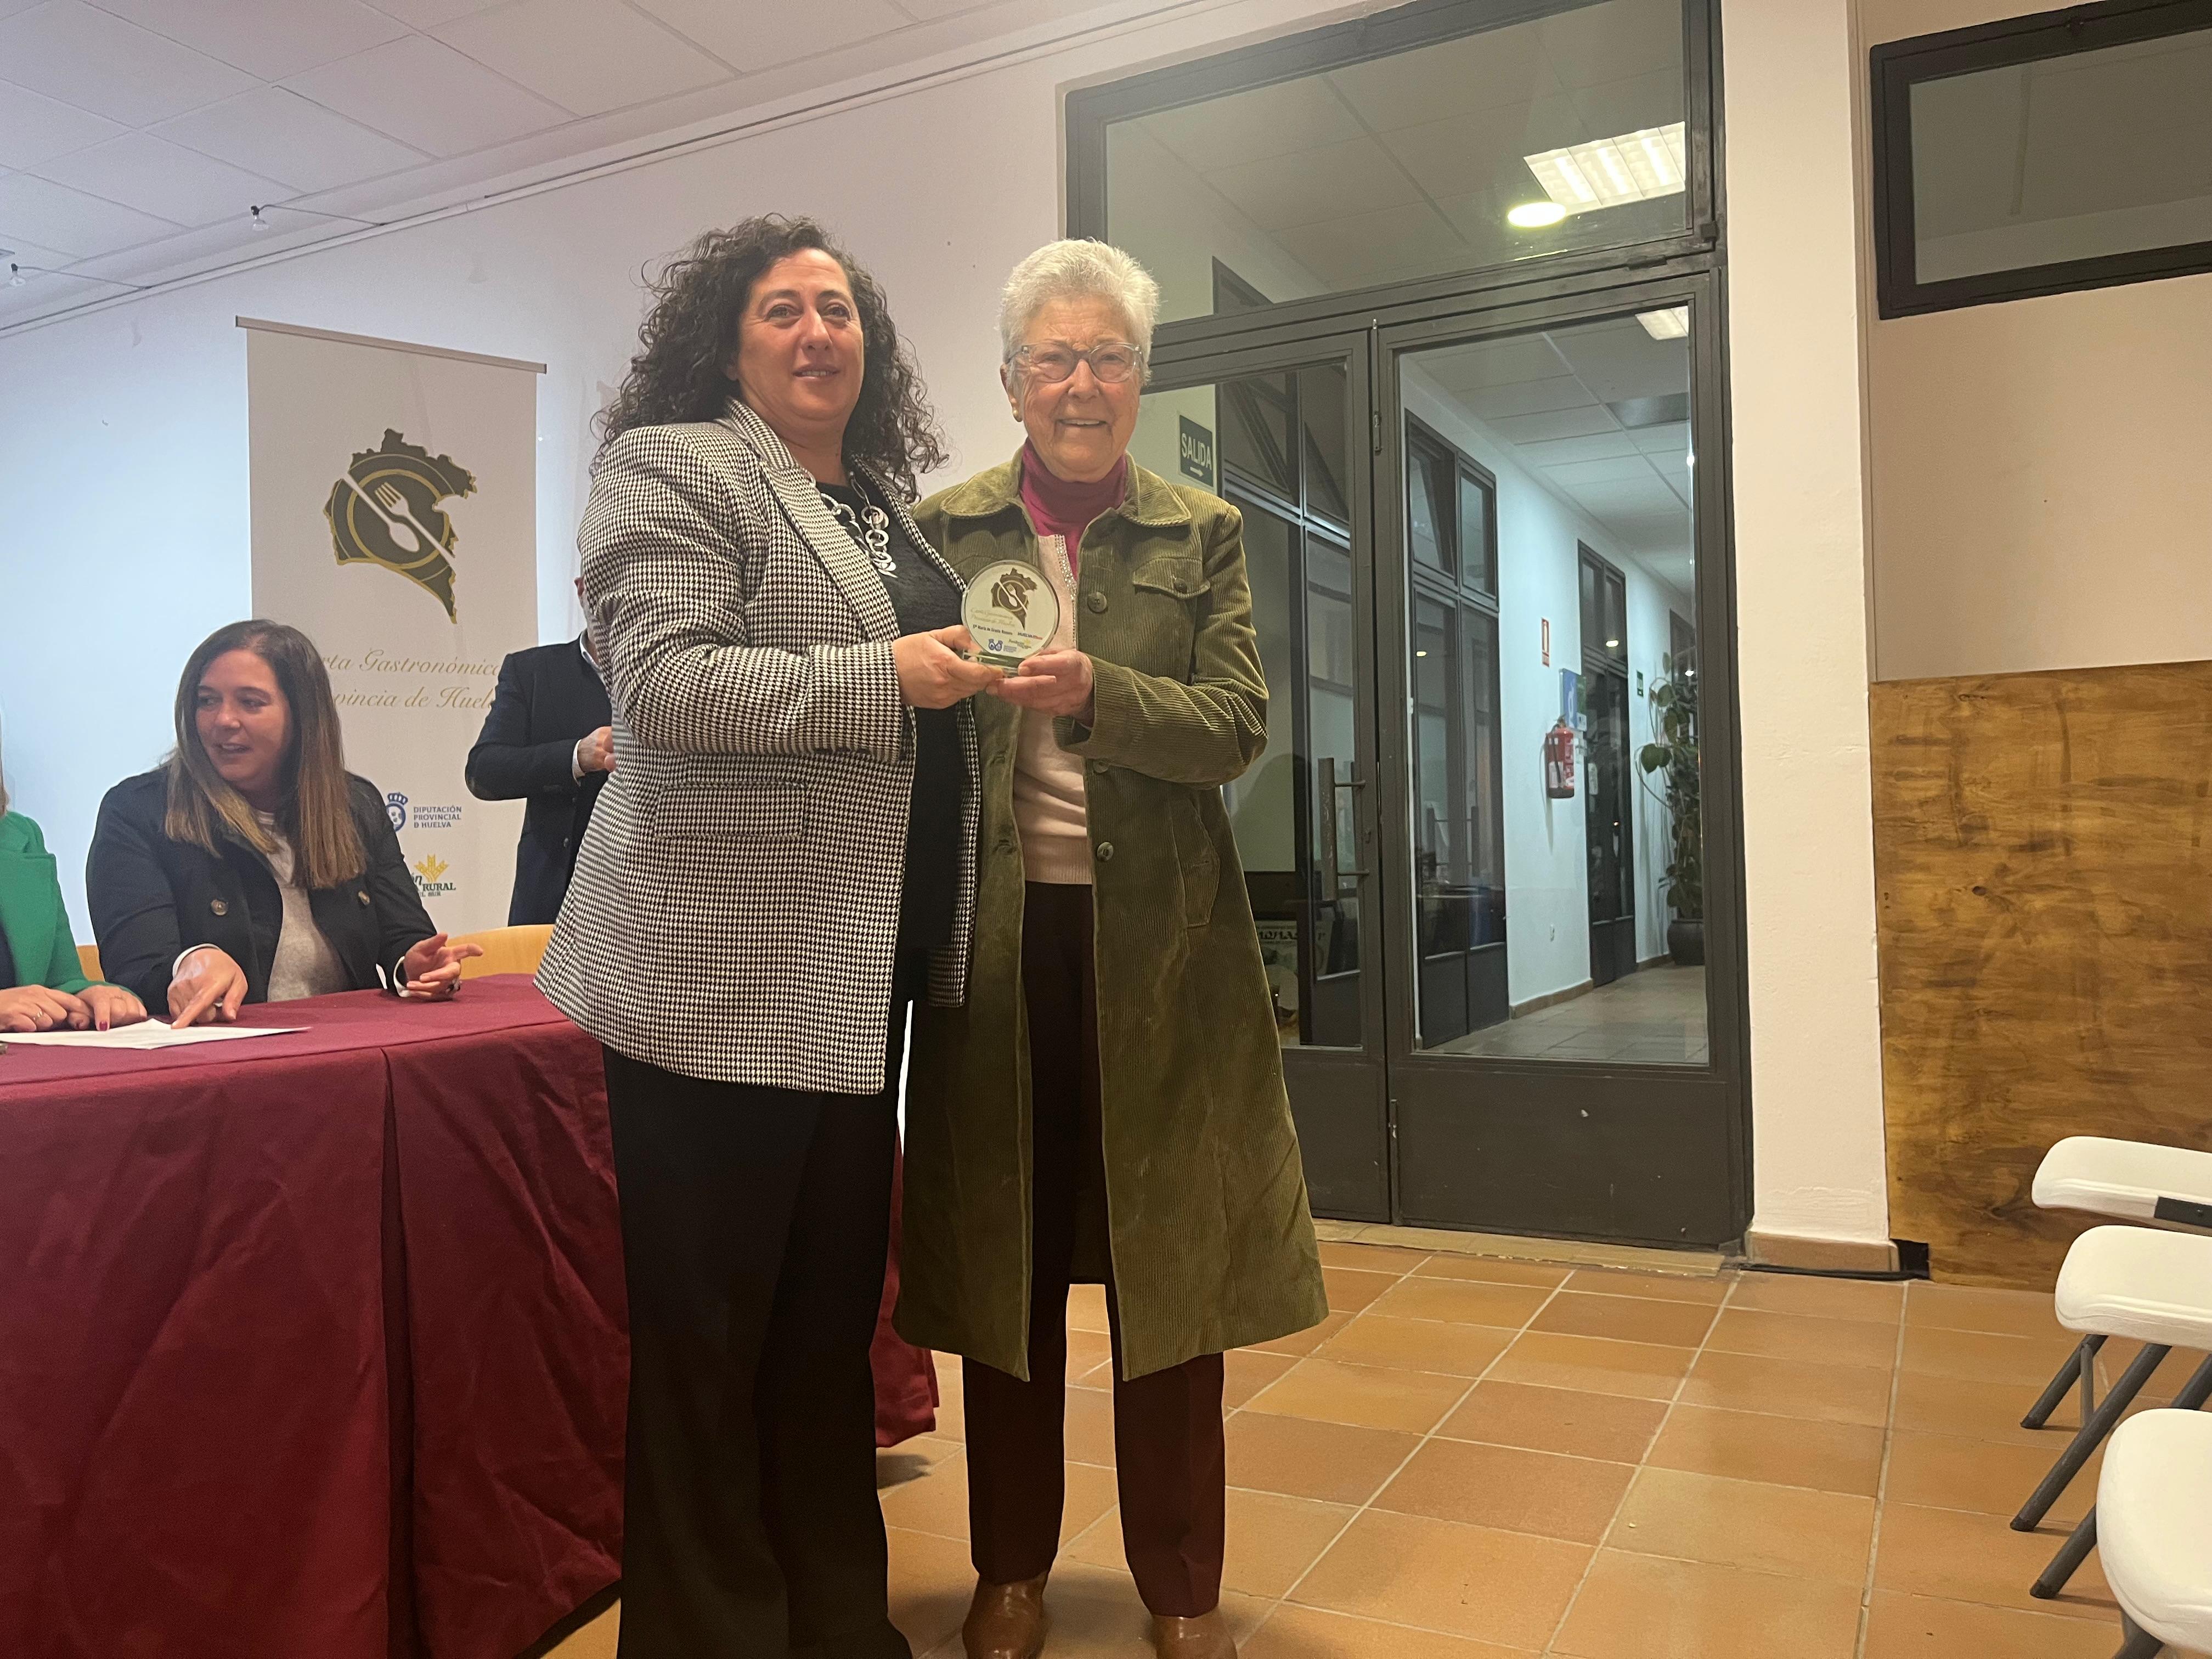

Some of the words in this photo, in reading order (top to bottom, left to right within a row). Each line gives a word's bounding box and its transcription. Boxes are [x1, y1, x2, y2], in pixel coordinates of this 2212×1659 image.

[1181, 432, 1212, 471] SALIDA
[334, 689, 398, 707] vincia
[404, 686, 430, 708] de
[437, 686, 495, 709] Huel
[413, 804, 462, 813] DIPUTACIÓN
[422, 882, 456, 892] RURAL
